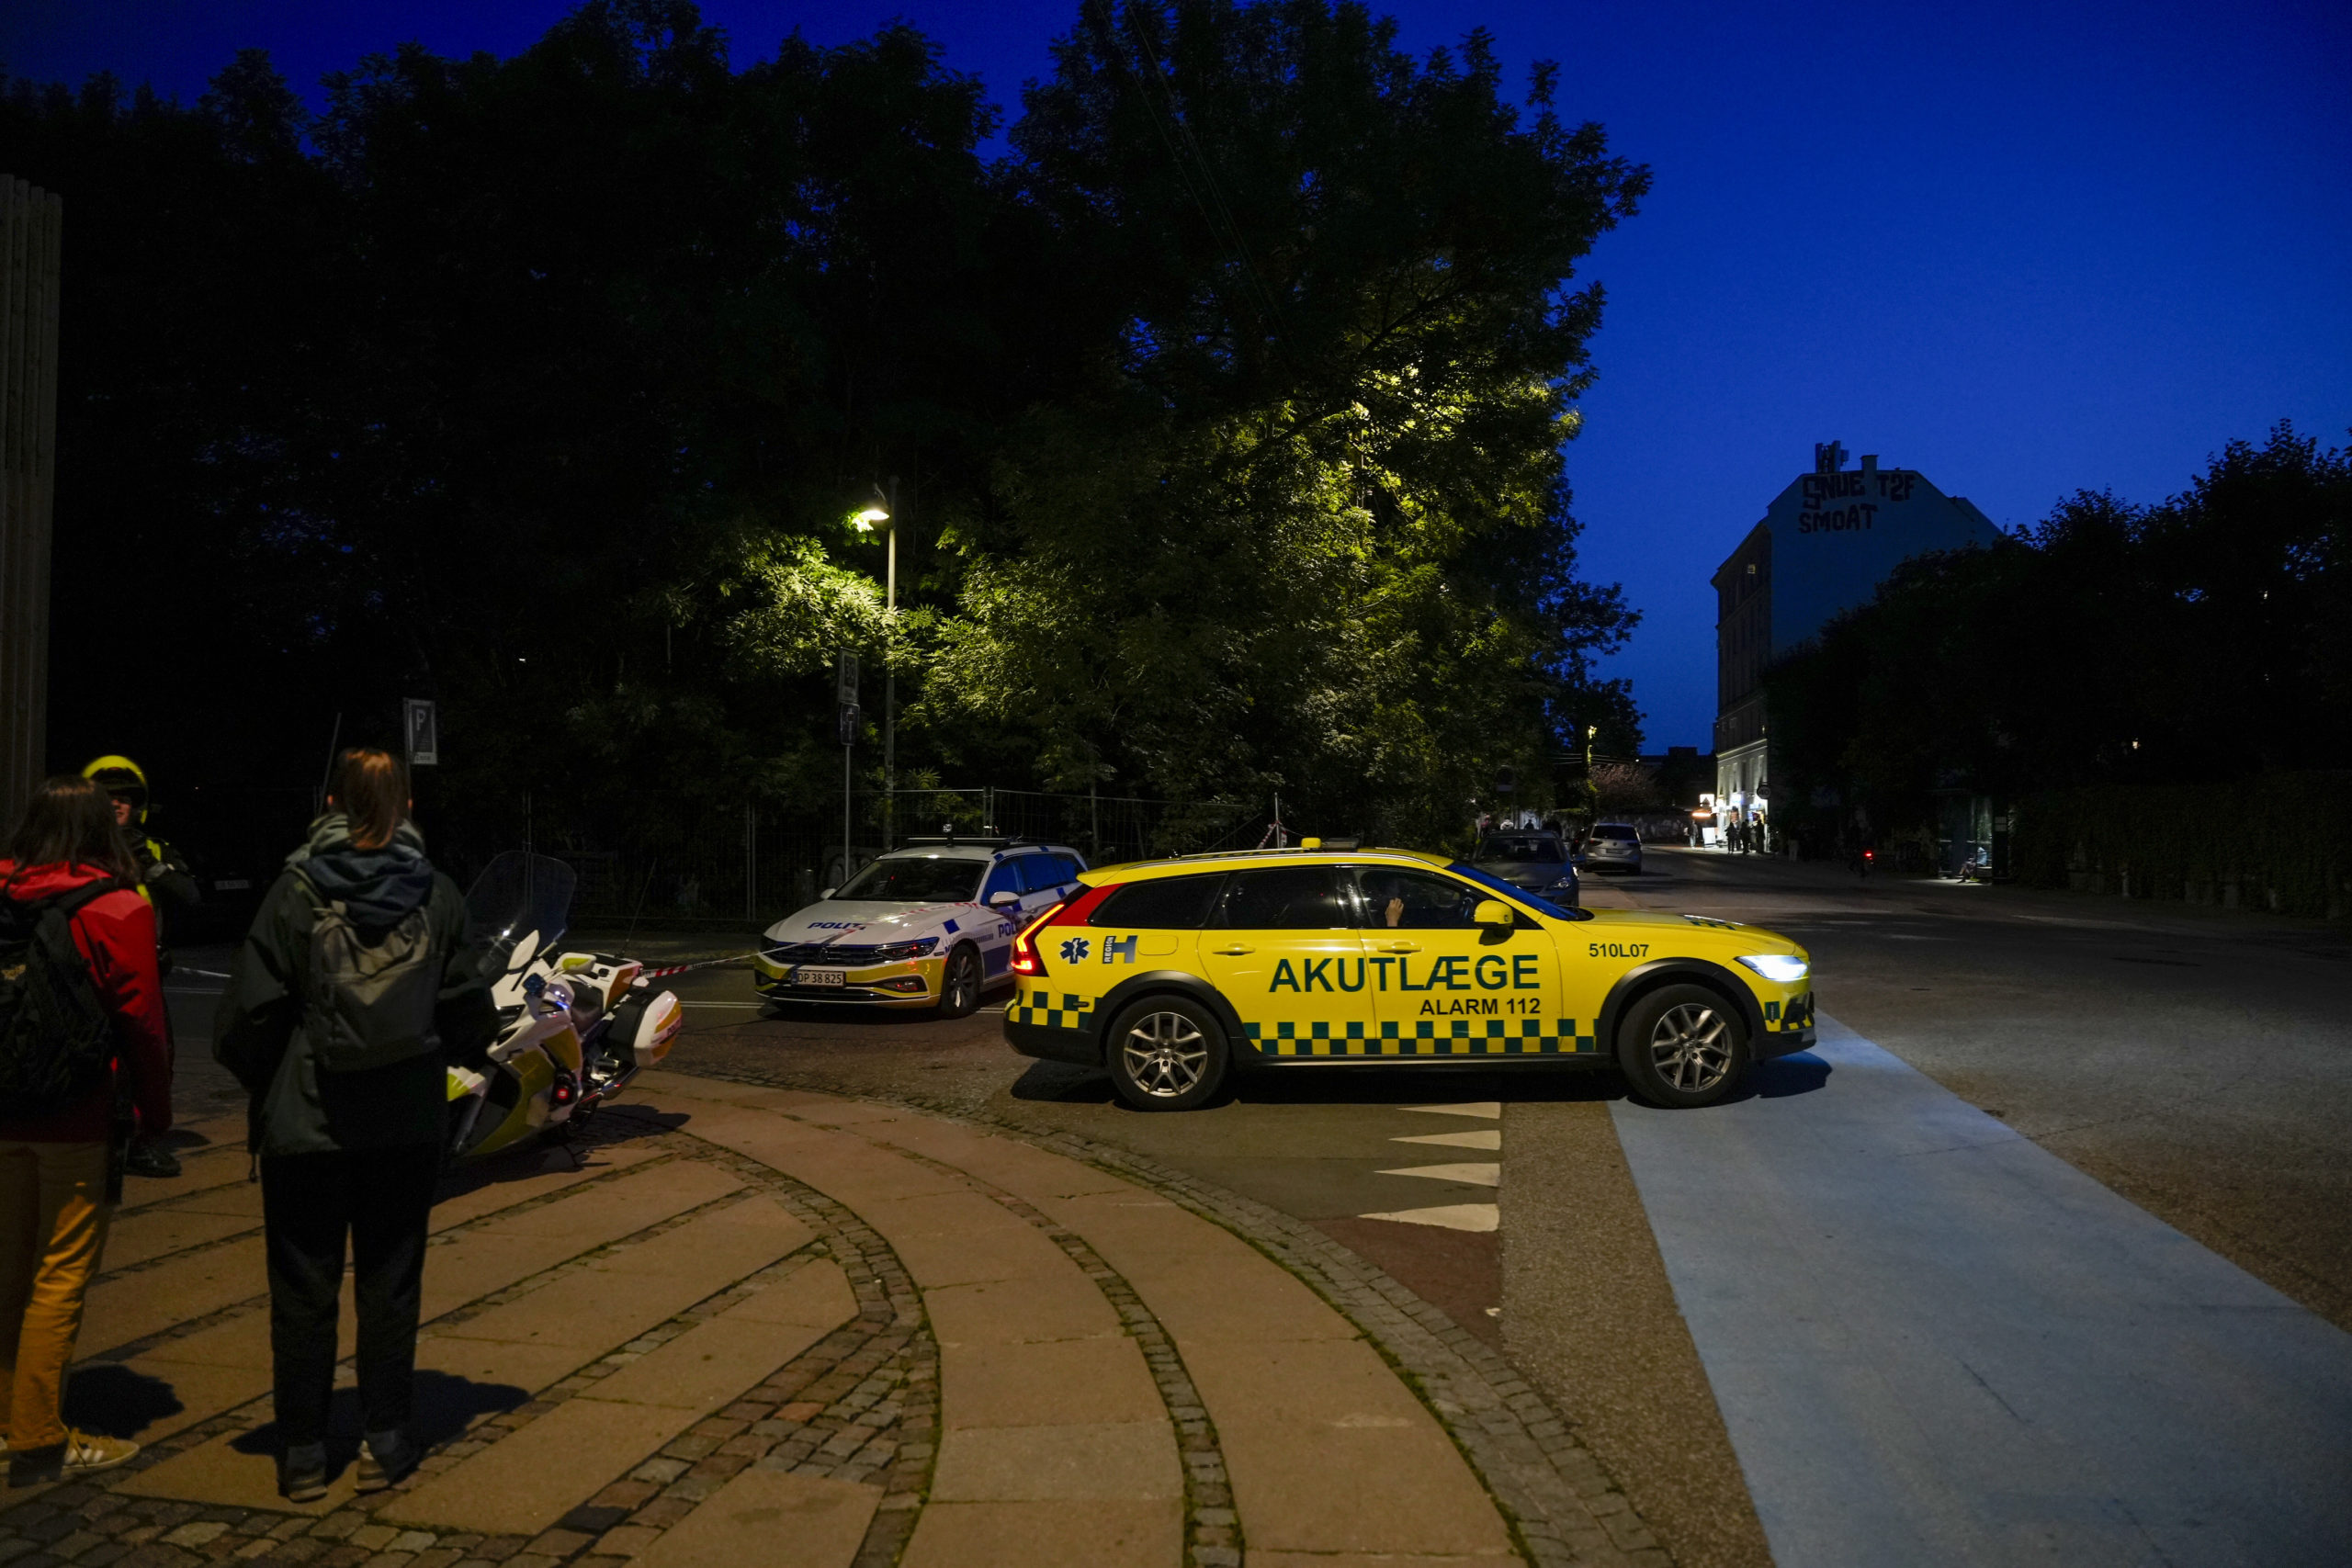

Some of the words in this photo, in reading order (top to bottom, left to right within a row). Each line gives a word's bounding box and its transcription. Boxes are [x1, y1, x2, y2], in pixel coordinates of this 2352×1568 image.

[1798, 503, 1878, 534] SMOAT
[1589, 943, 1649, 957] 510L07
[797, 973, 809, 983] DP
[812, 974, 823, 984] 38
[825, 974, 842, 984] 825
[1268, 954, 1541, 993] AKUTLÆGE
[1419, 998, 1498, 1015] ALARM
[1506, 998, 1541, 1014] 112
